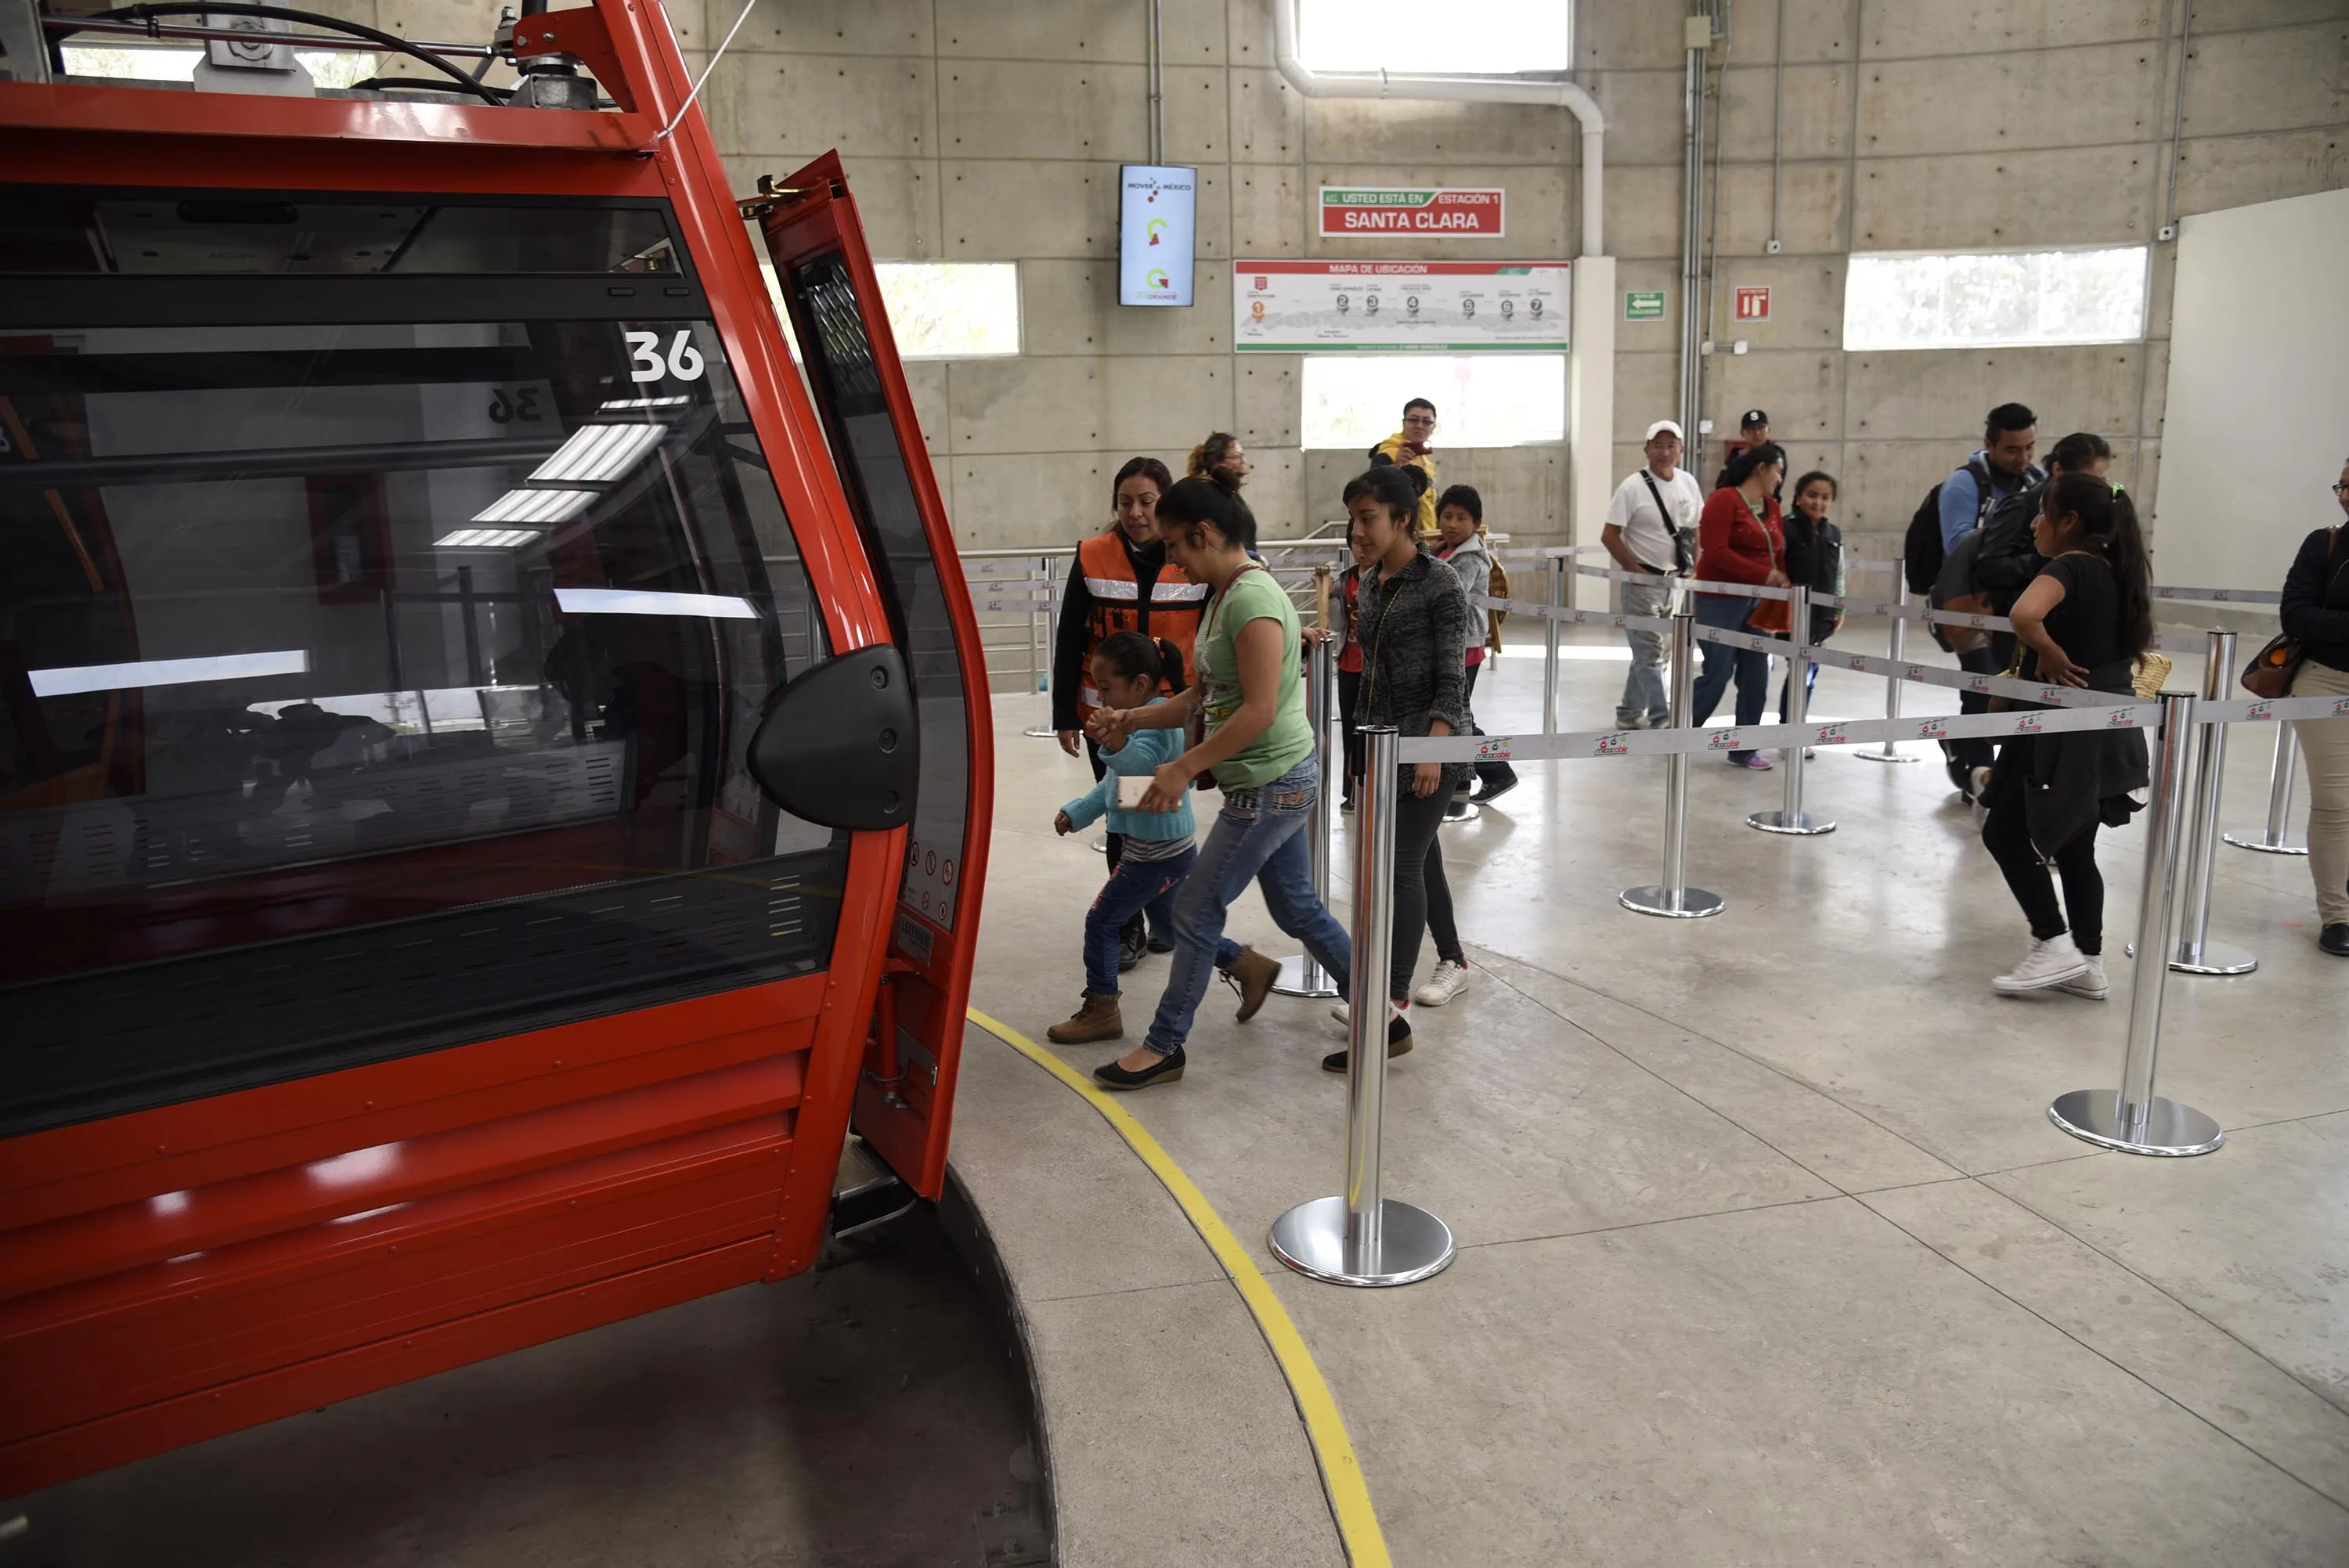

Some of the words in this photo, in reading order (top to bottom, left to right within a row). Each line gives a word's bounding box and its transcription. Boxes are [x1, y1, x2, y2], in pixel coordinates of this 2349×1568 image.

[1342, 193, 1377, 204] USTED
[1379, 193, 1407, 204] ESTÁ
[1409, 194, 1423, 204] EN
[1438, 193, 1489, 204] ESTACIÓN
[1492, 196, 1499, 204] 1
[1344, 211, 1411, 229] SANTA
[1416, 212, 1479, 229] CLARA
[1329, 264, 1359, 274] MAPA
[1360, 264, 1373, 274] DE
[1375, 263, 1428, 274] UBICACIÓN
[625, 330, 704, 383] 36
